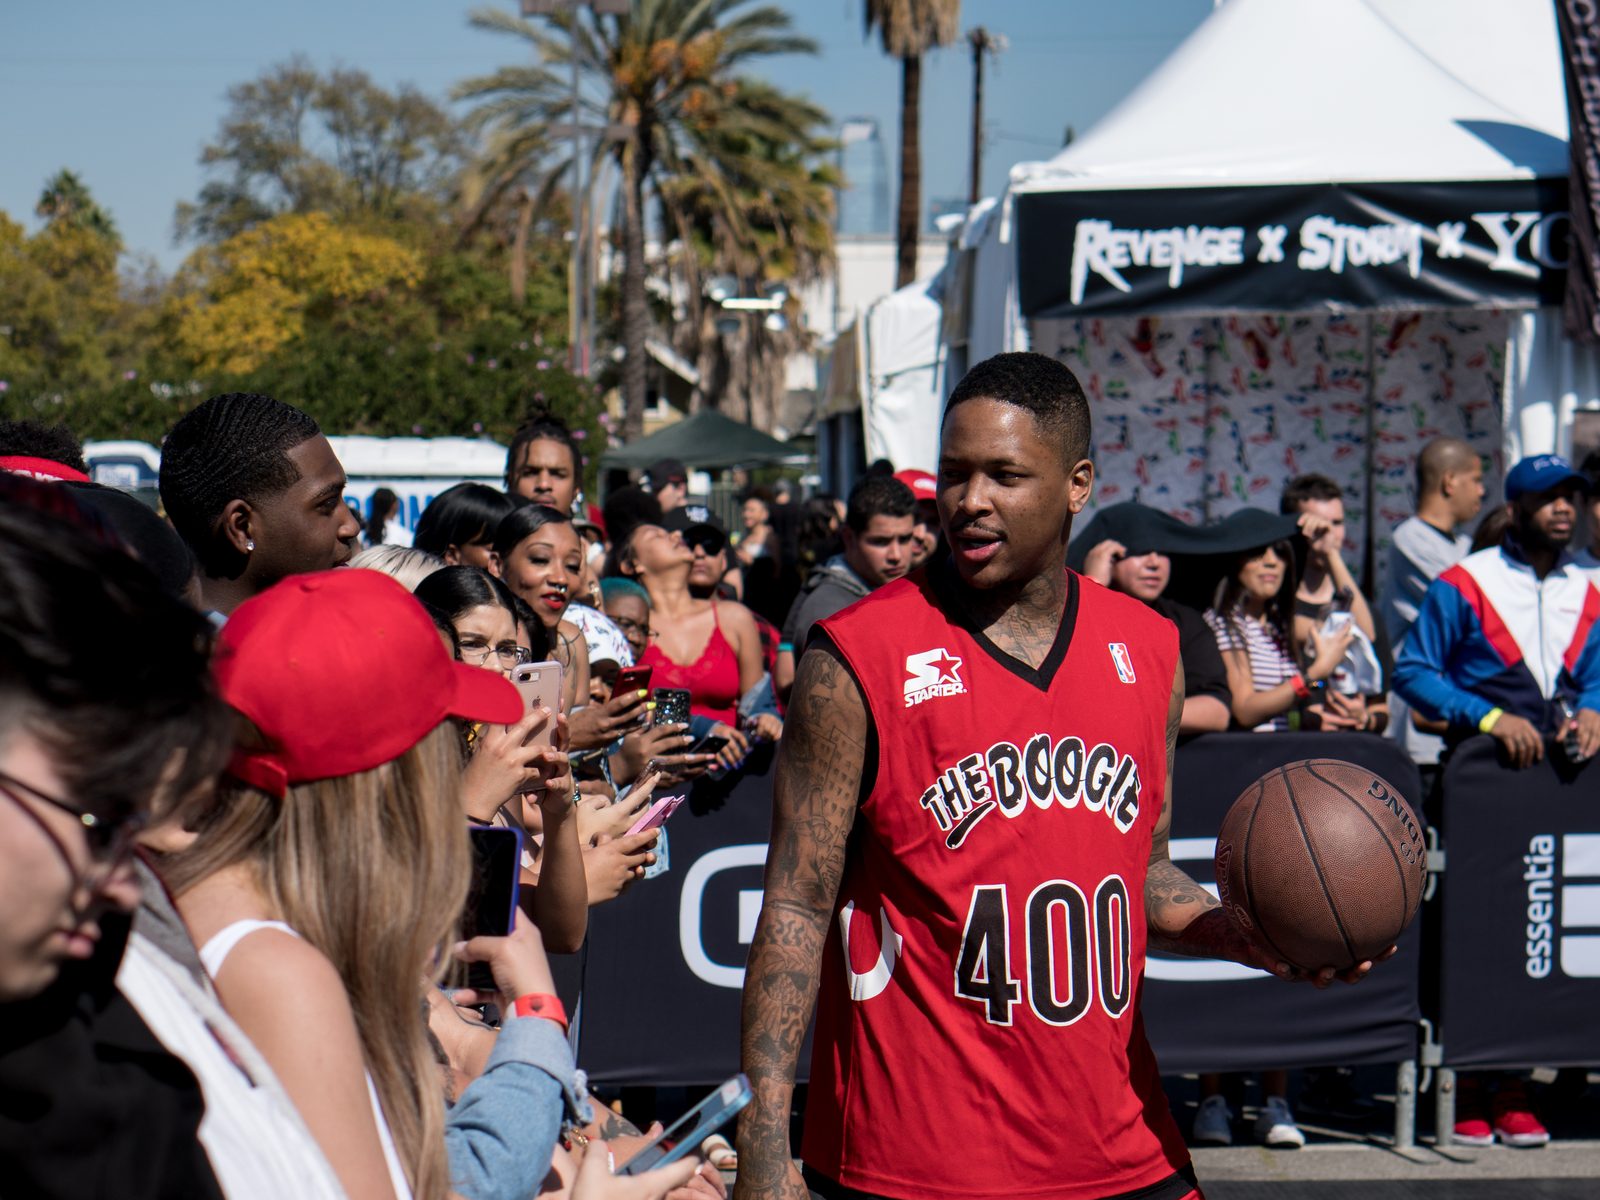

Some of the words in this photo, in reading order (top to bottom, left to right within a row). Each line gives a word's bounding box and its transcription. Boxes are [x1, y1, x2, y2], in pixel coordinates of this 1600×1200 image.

[1070, 218, 1245, 305] REVENGE
[1298, 214, 1423, 279] STORM
[904, 682, 965, 708] STARTER
[919, 752, 992, 831] THE
[985, 733, 1142, 834] BOOGIE
[954, 874, 1131, 1027] 400
[1523, 833, 1555, 979] essentia
